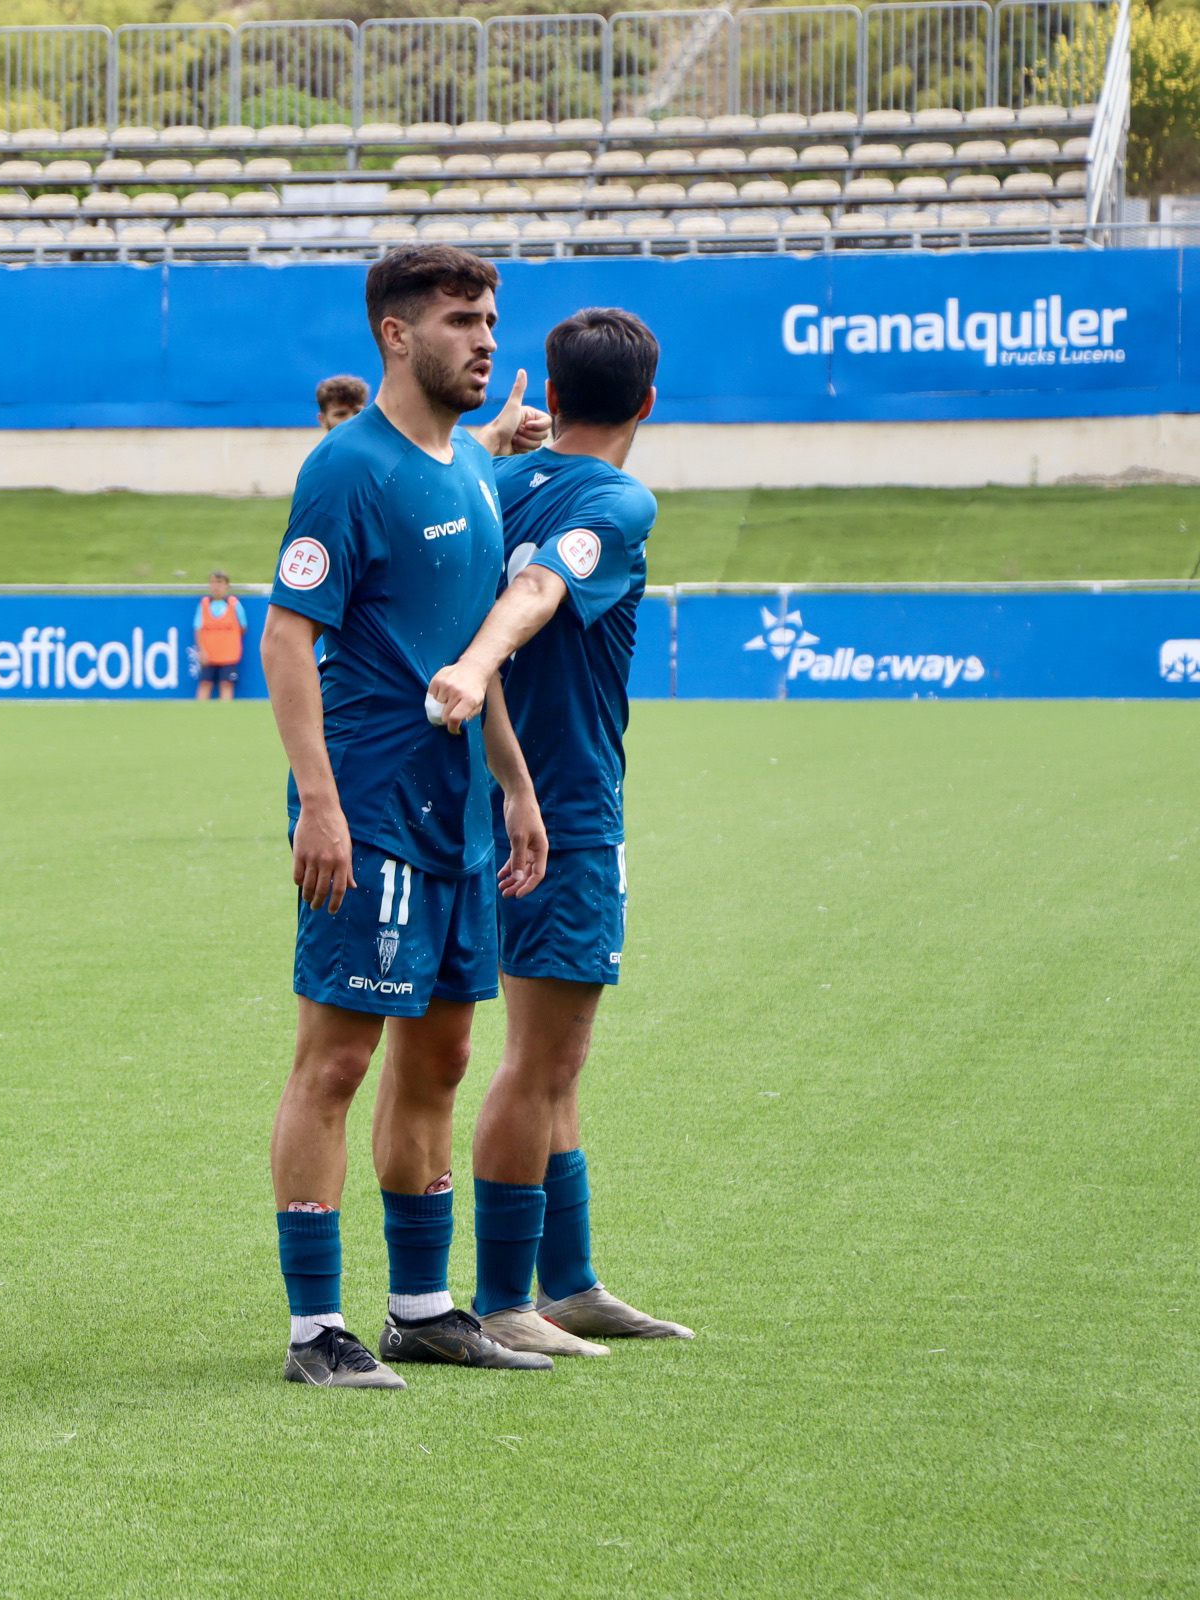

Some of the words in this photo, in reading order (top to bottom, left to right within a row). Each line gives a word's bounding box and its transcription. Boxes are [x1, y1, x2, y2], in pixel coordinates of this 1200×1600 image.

[783, 294, 1127, 366] Granalquiler
[1001, 349, 1056, 366] trucks
[423, 517, 467, 540] GIVOVA
[378, 859, 413, 926] 11
[348, 976, 413, 995] GIVOVA
